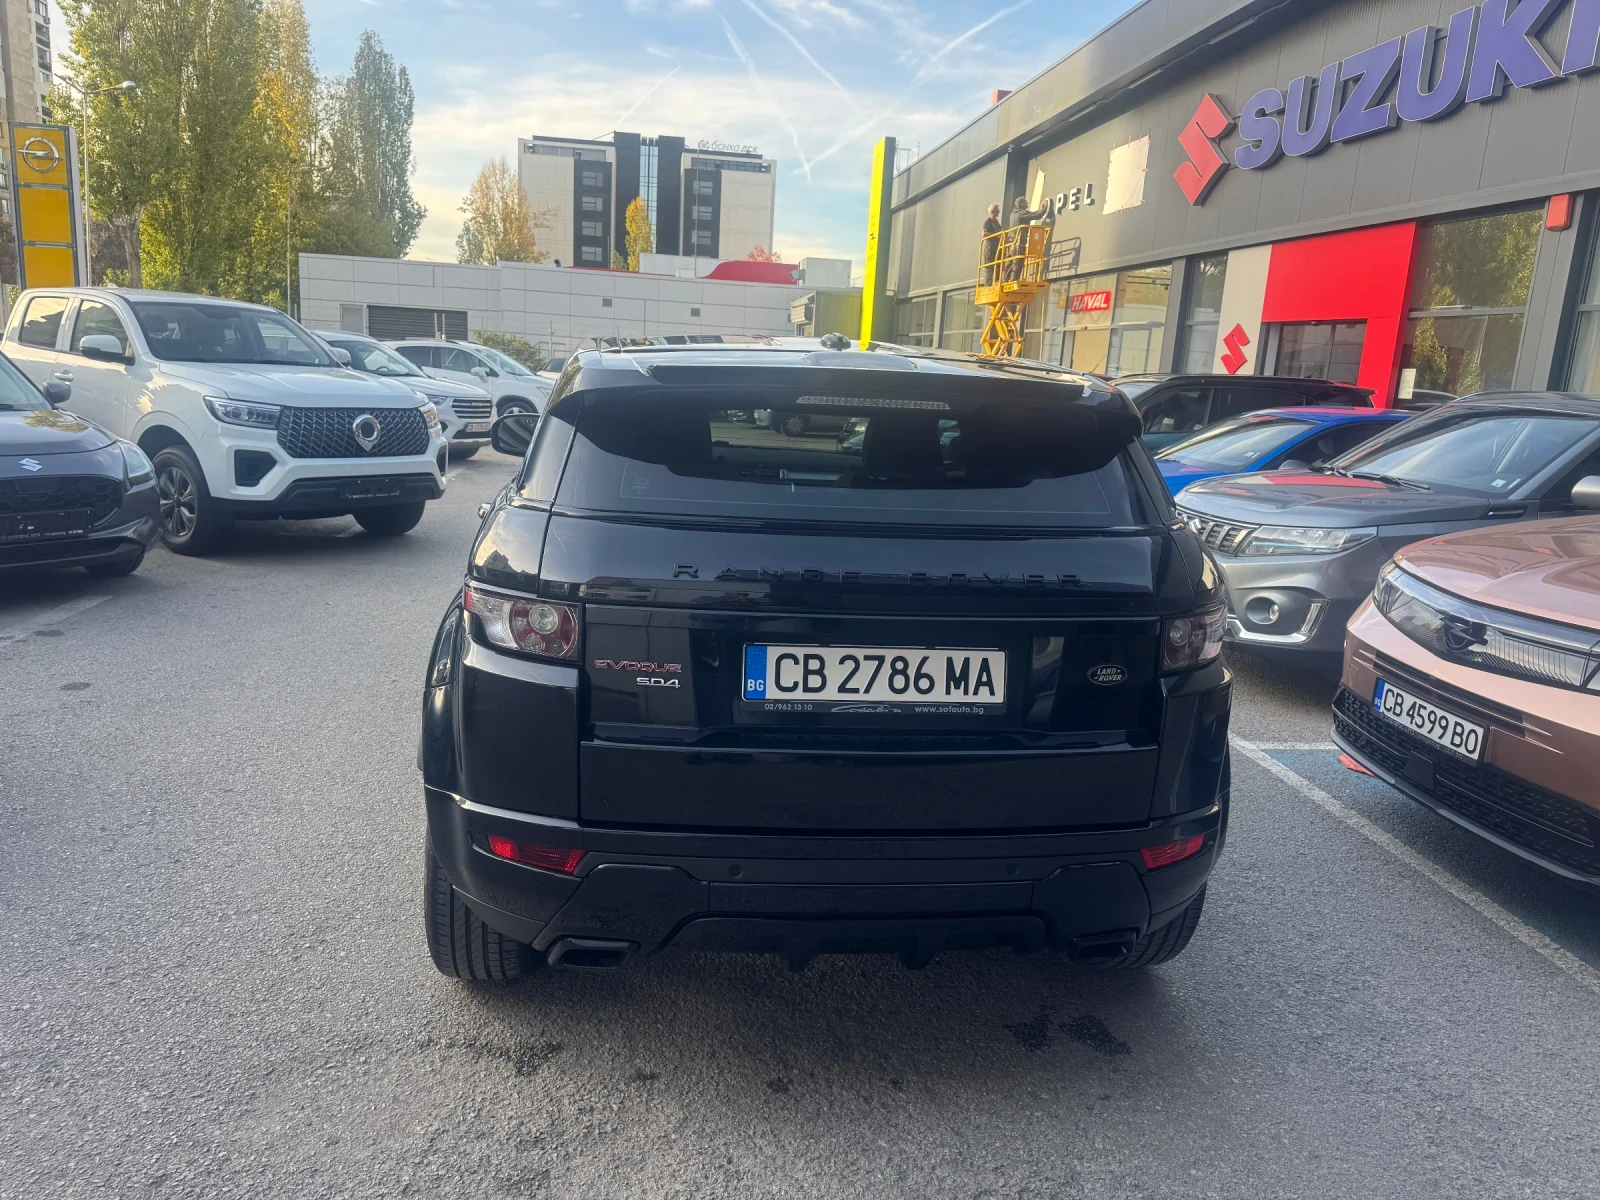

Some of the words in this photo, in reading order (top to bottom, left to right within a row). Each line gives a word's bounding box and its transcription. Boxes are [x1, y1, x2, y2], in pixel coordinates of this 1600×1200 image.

[1234, 0, 1600, 170] SUZUKI
[1071, 293, 1109, 311] HAVAL
[672, 562, 862, 584] RANGE
[906, 571, 1083, 588] ROVER
[594, 659, 682, 673] EVOQUE
[747, 680, 764, 692] BG
[774, 653, 827, 694] CB
[837, 655, 935, 695] 2786
[944, 656, 996, 697] MA
[636, 677, 681, 689] SD4
[764, 703, 792, 711] 02/962
[794, 703, 802, 711] 13
[803, 703, 813, 711] 10
[914, 705, 984, 715] www.sofauto.bg
[1383, 688, 1405, 717] CB
[1406, 700, 1449, 741] 4599
